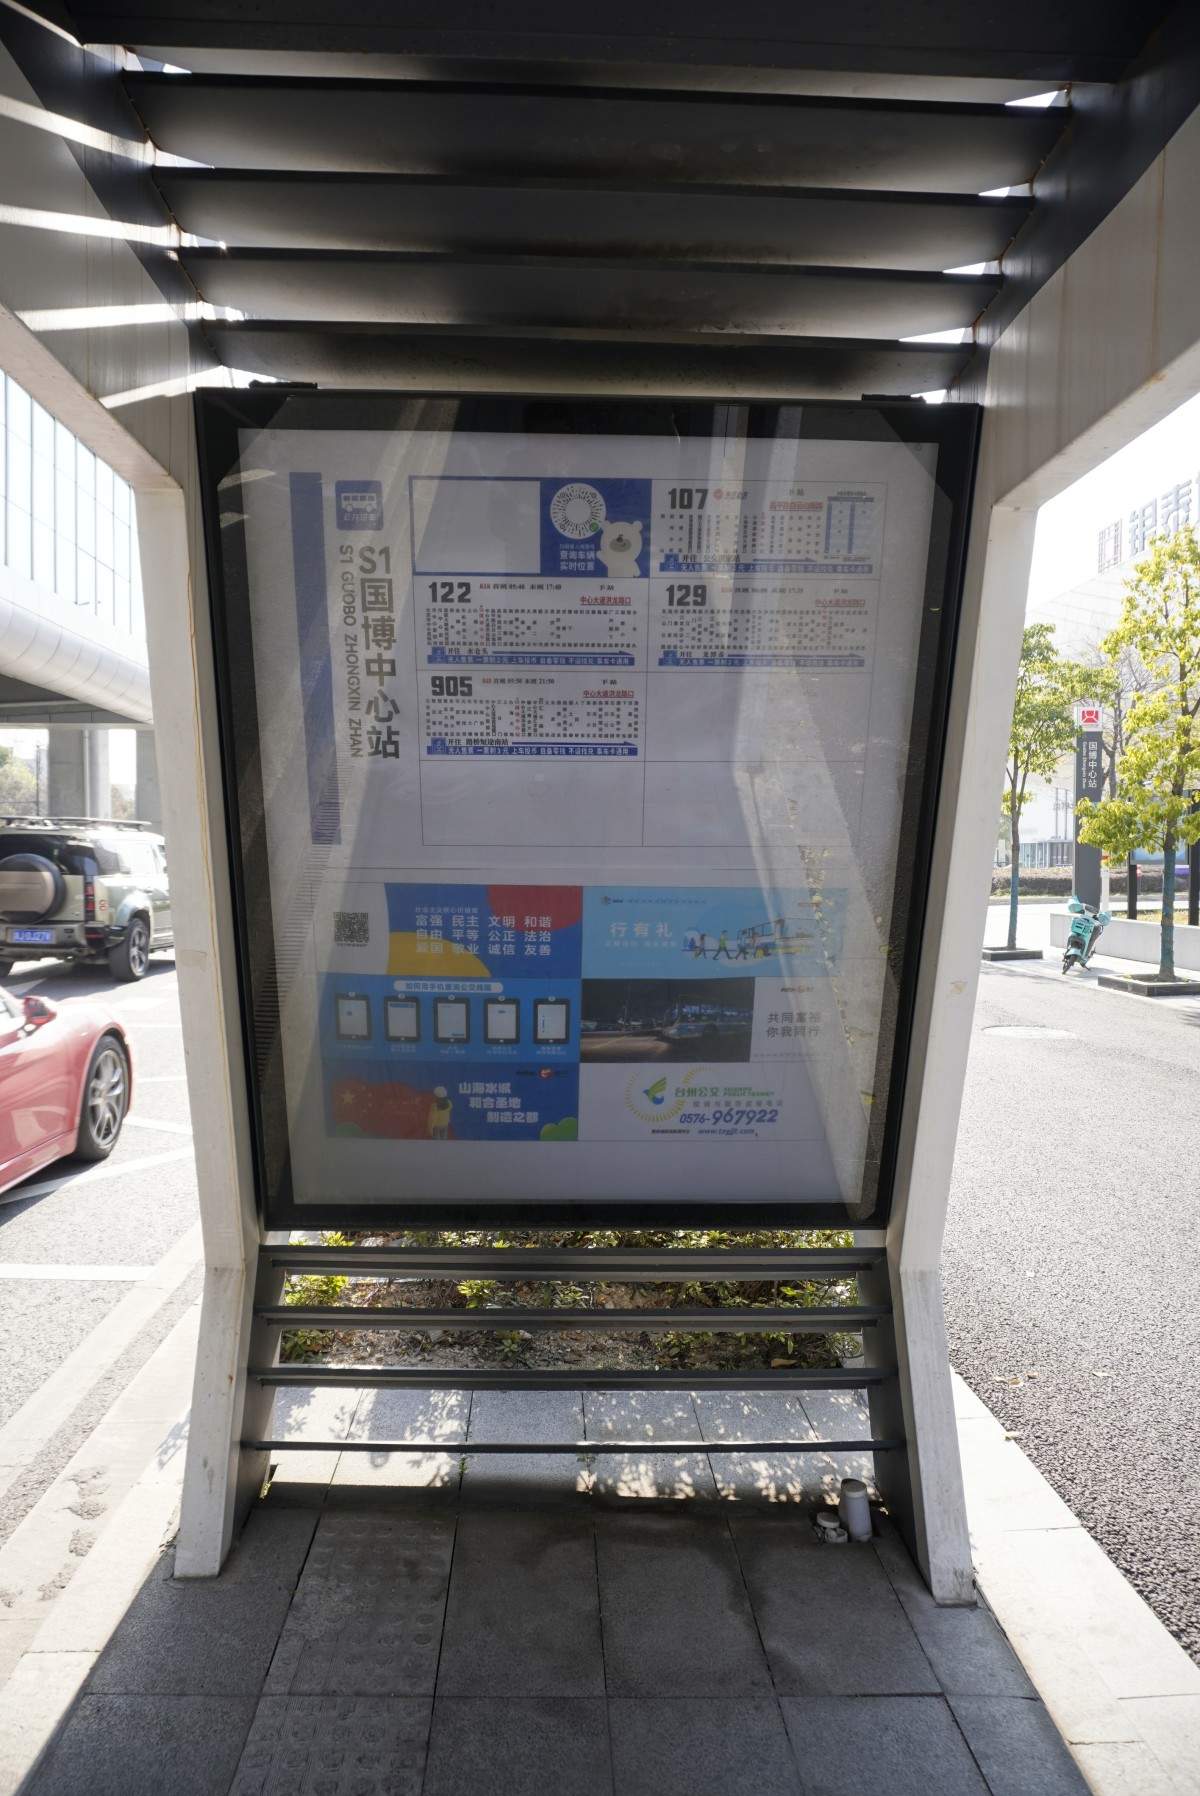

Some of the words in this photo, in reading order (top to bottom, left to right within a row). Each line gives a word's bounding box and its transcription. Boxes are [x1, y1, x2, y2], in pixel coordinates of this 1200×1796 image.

[668, 488, 708, 509] 107
[339, 544, 354, 564] S1
[341, 571, 357, 627] GUOBO
[428, 582, 472, 603] 122
[666, 584, 707, 606] 129
[358, 545, 401, 760] S1国博中心站
[344, 634, 361, 711] ZHONGXIN
[431, 676, 472, 696] 905
[348, 718, 363, 758] ZHAN
[1088, 741, 1098, 788] 国博中心站
[415, 915, 443, 927] 富强
[452, 915, 480, 928] 民主
[488, 916, 516, 928] 文明
[524, 916, 552, 928] 和谐
[609, 922, 673, 938] 行有礼
[415, 929, 443, 941] 自由
[452, 929, 480, 942] 平等
[488, 930, 516, 942] 公正
[524, 930, 552, 942] 法治
[452, 943, 480, 955] 敬业
[488, 944, 516, 956] 诚信
[524, 944, 552, 957] 友善
[766, 1026, 822, 1038] 你我同行
[674, 1087, 720, 1098] 台州公交
[469, 1097, 521, 1109] 和合圣地
[486, 1112, 539, 1123] 制造之都
[679, 1108, 779, 1125] 0576-967922
